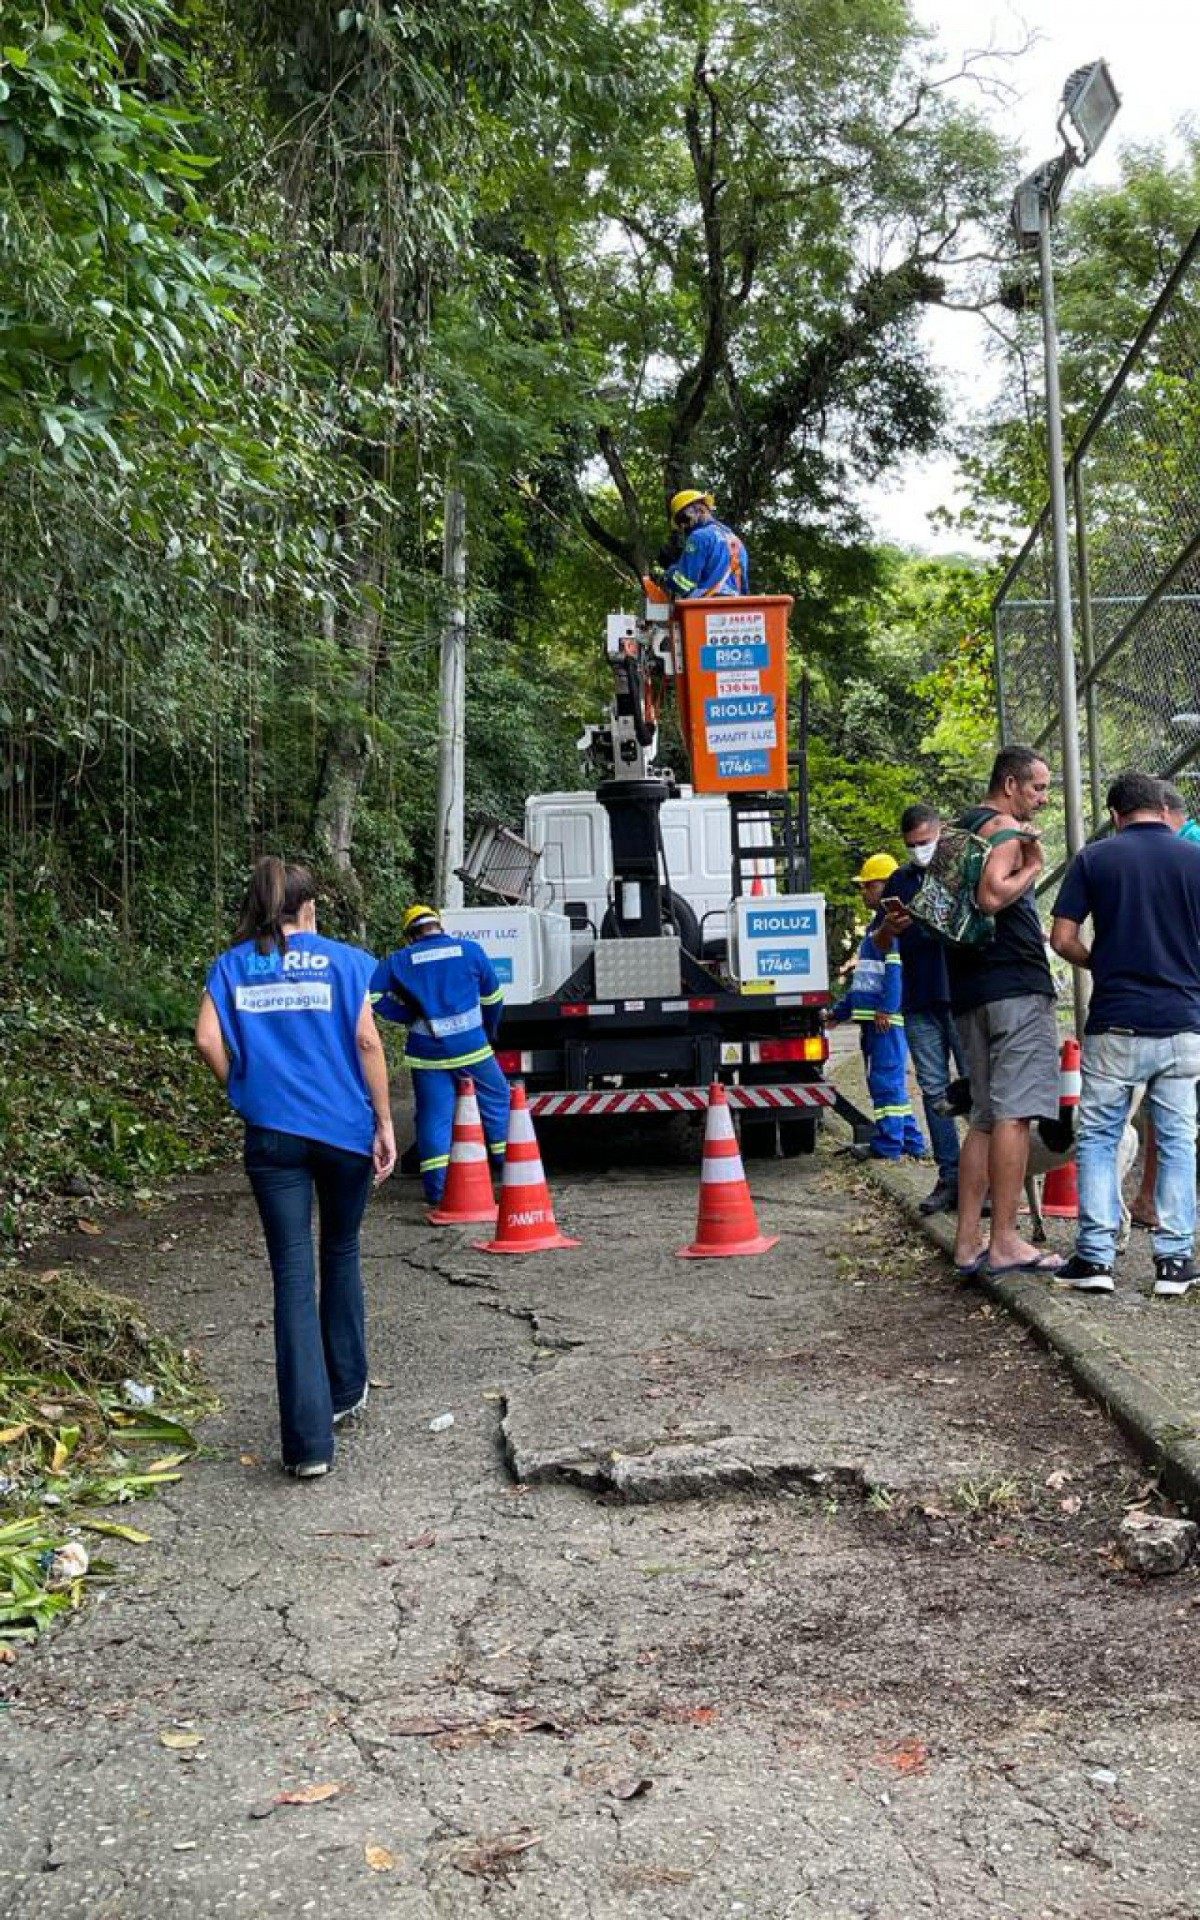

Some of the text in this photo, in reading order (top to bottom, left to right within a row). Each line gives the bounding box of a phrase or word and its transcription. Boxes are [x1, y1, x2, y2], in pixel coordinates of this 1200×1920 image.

[715, 649, 741, 662] RIO
[710, 701, 769, 718] RIOLUZ
[719, 758, 752, 776] 1746
[753, 917, 811, 931] RIOLUZ
[283, 951, 330, 972] Rio
[759, 957, 792, 973] 1746
